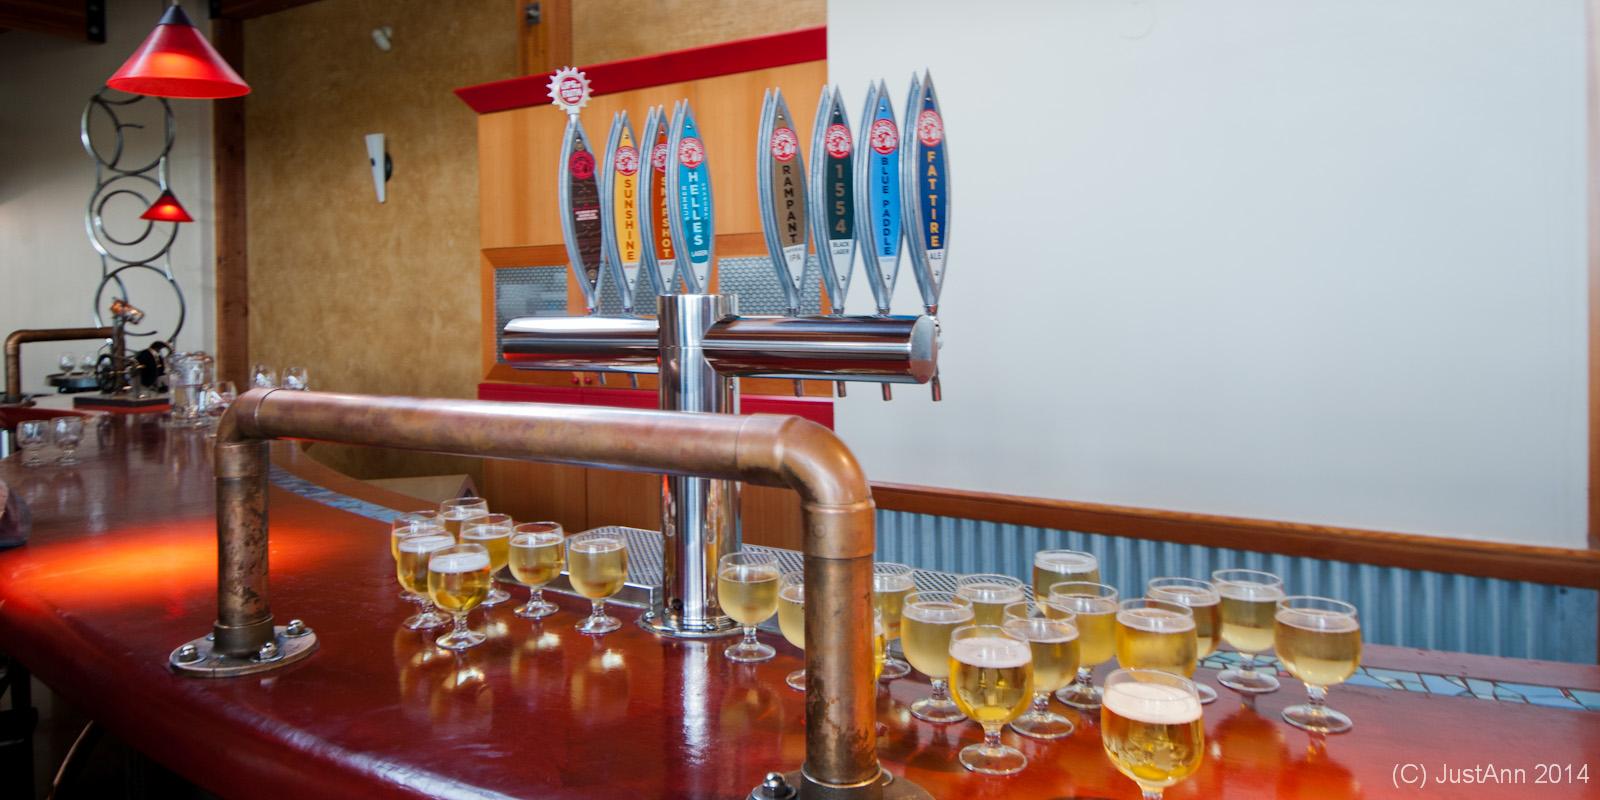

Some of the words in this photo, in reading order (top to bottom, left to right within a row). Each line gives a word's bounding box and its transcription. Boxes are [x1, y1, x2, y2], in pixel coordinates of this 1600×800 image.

[835, 163, 847, 234] 1554
[881, 157, 889, 194] BLUE
[927, 151, 938, 190] FAT
[624, 179, 635, 261] SUNSHINE
[688, 172, 704, 246] HELLES
[782, 165, 798, 244] RAMPANT
[882, 199, 891, 255] PADDLE
[928, 194, 940, 248] TIRE
